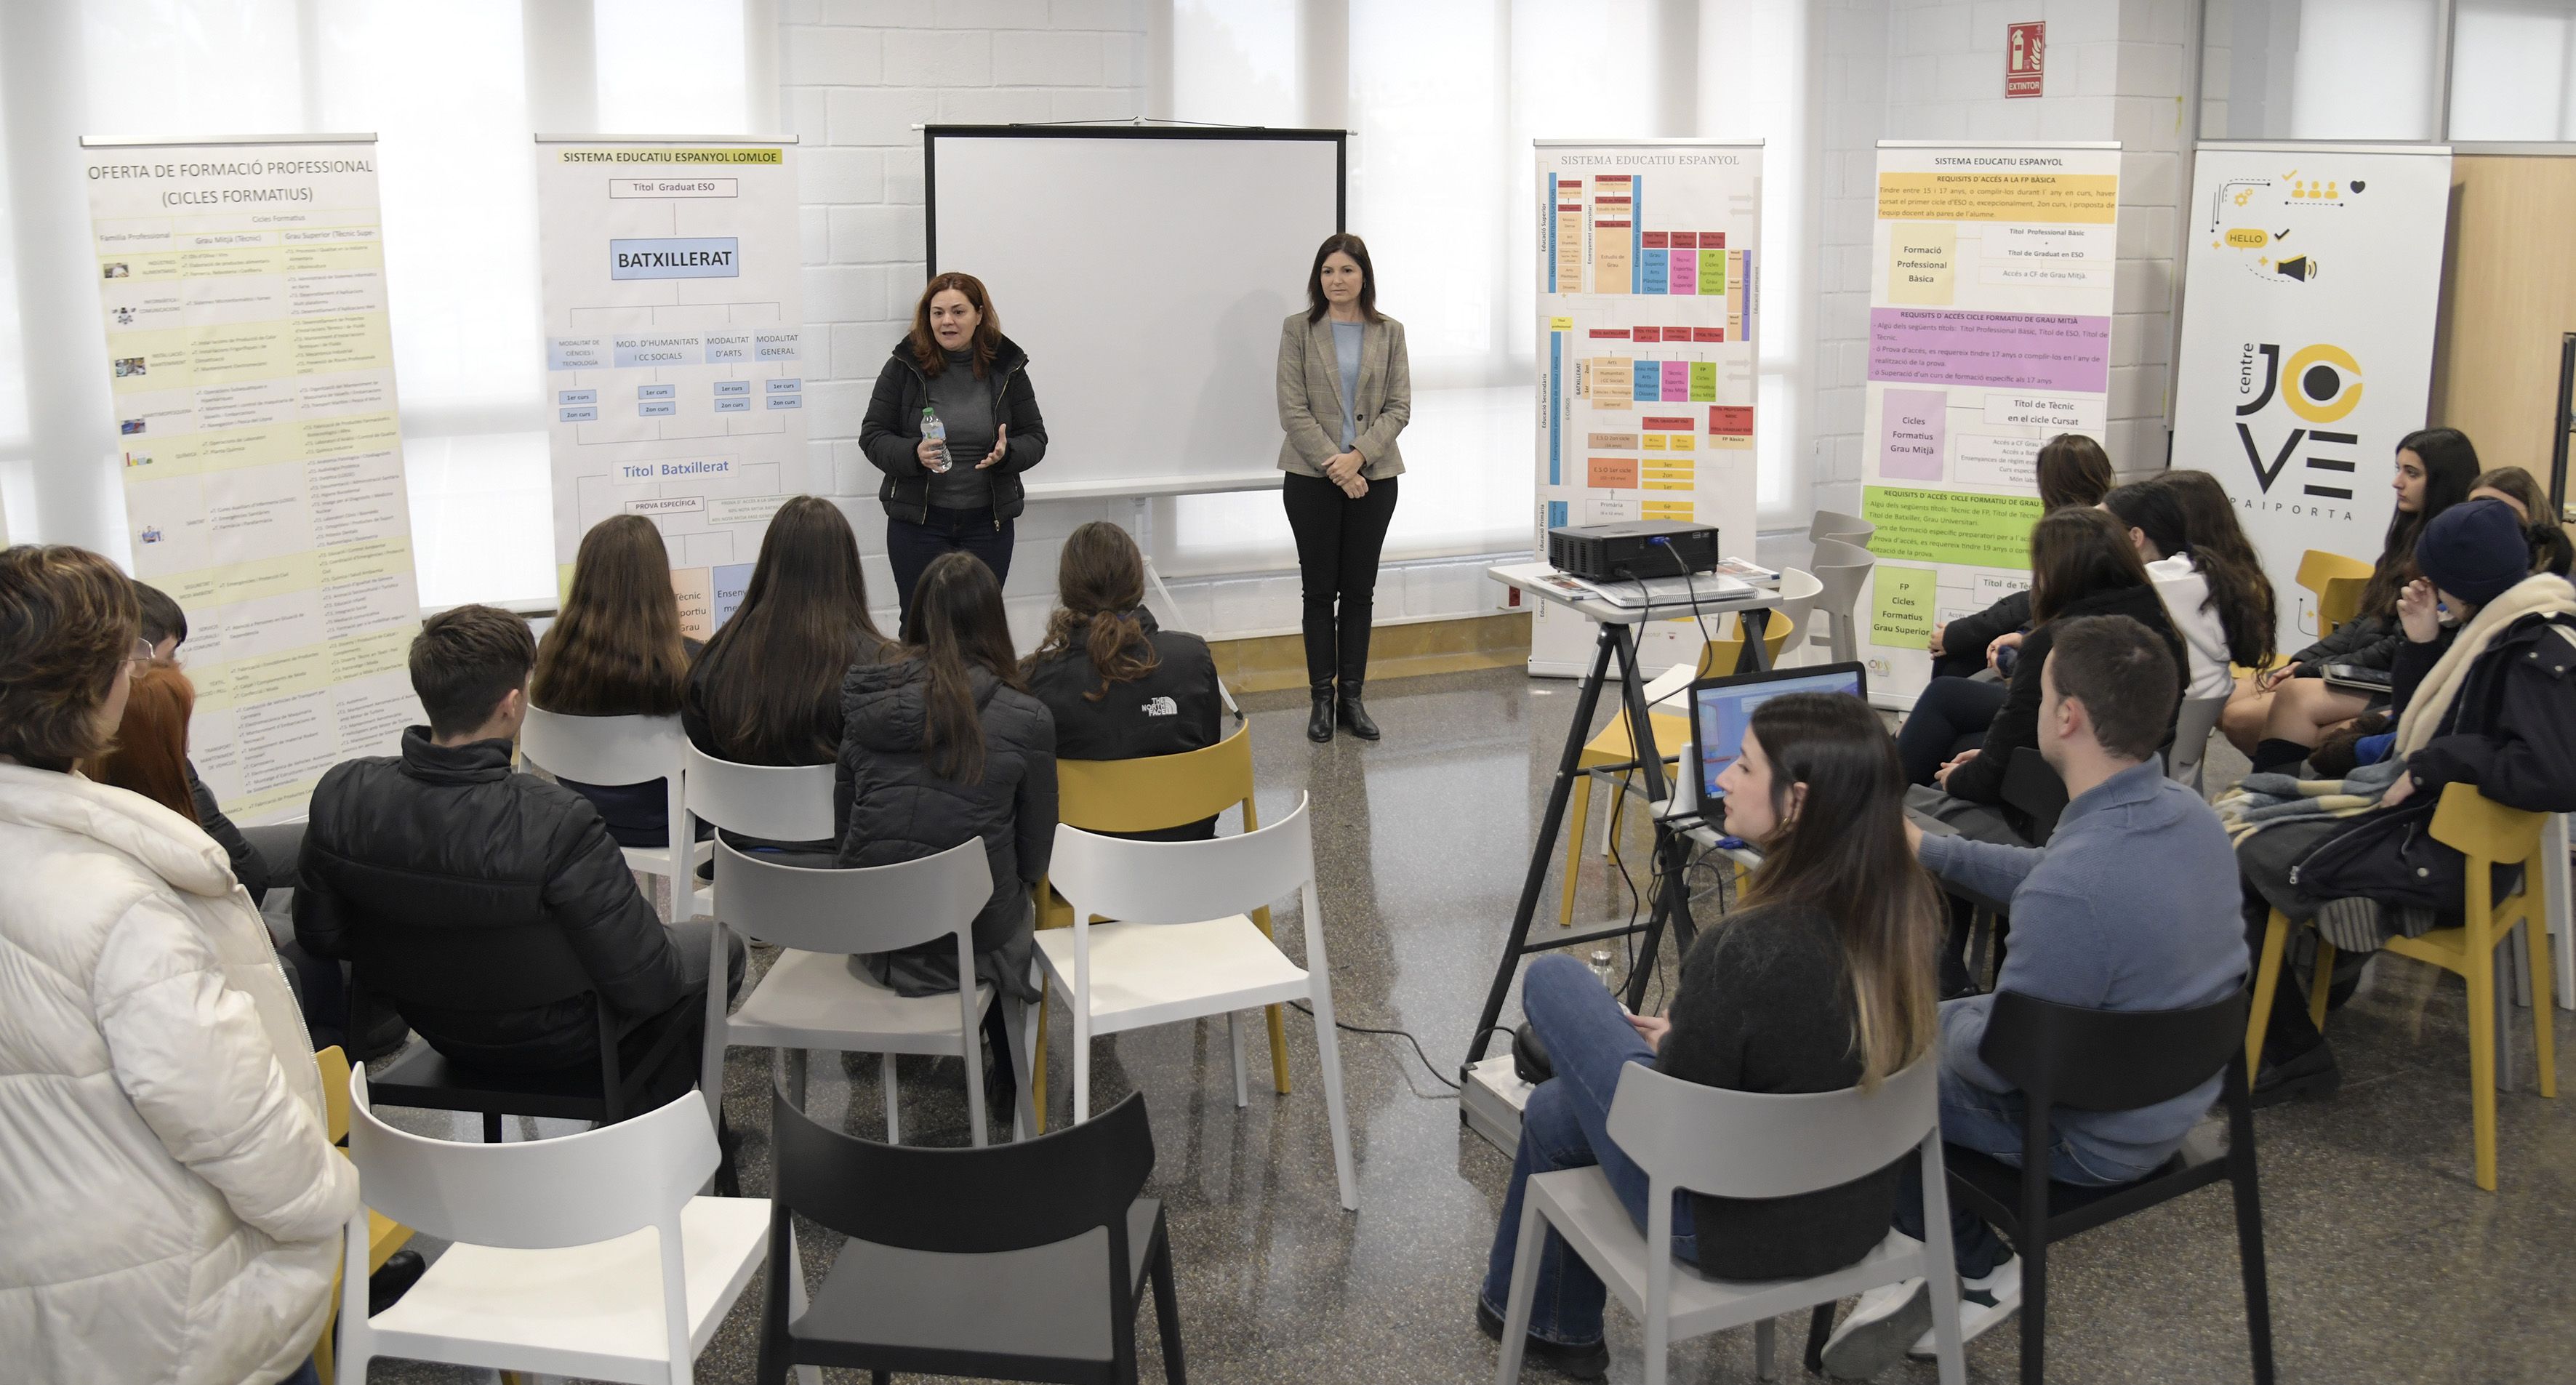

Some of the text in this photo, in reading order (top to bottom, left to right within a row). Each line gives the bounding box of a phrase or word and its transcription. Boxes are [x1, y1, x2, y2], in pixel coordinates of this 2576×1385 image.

[2009, 81, 2040, 90] EXTINTOR
[563, 152, 777, 162] SISTEMA EDUCATIU ESPANYOL LOMLOE
[1561, 156, 1740, 165] SISTEMA EDUCATIU ESPANYOL
[88, 158, 373, 180] OFERTA DE FORMACIÓ PROFESSIONAL
[659, 182, 695, 191] Graduat
[697, 182, 715, 191] ESO
[162, 186, 313, 209] (CICLES FORMATIUS)
[2229, 233, 2263, 244] HELLO
[1903, 246, 1942, 254] Formació
[618, 251, 732, 268] BATXILLERAT
[1897, 260, 1947, 269] Professional
[1909, 274, 1934, 283] Bàsica
[707, 336, 750, 345] MODALITAT
[2239, 342, 2254, 394] centre
[2048, 401, 2074, 410] Tècnic
[1902, 417, 1925, 425] Cicles
[2051, 417, 2079, 425] Cursat
[1893, 430, 1933, 441] Formatius
[1890, 444, 1934, 456] Grau Mitjà
[623, 460, 729, 478] Títol Batxillerat
[660, 499, 696, 508] ESPECÍFICA
[1970, 496, 2007, 505] FORMATIU
[2007, 581, 2017, 590] de
[1892, 597, 1915, 606] Cicles
[1882, 611, 1922, 622] Formatius
[1874, 624, 1930, 635] Grau Superior
[1141, 703, 1165, 712] NORTH
